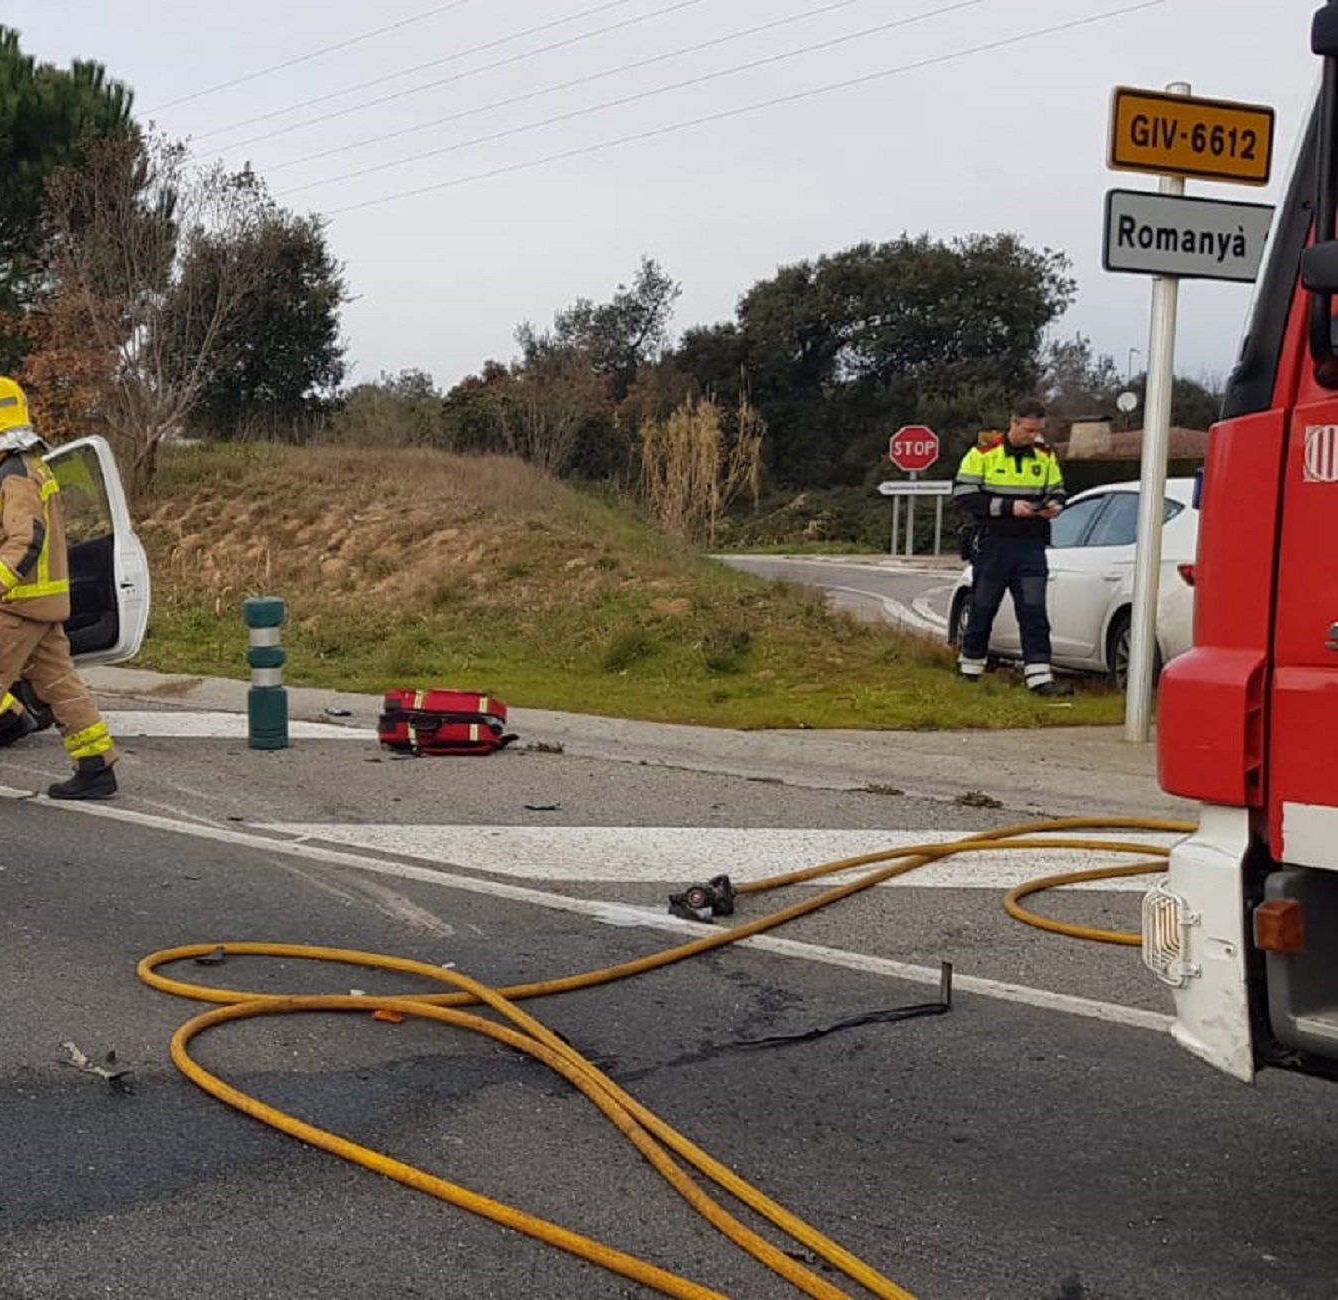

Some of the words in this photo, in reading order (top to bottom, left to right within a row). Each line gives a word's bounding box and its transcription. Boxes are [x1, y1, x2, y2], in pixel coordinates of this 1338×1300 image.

[1130, 114, 1257, 161] GIV-6612
[1117, 214, 1246, 263] Romanyà
[894, 441, 936, 456] STOP
